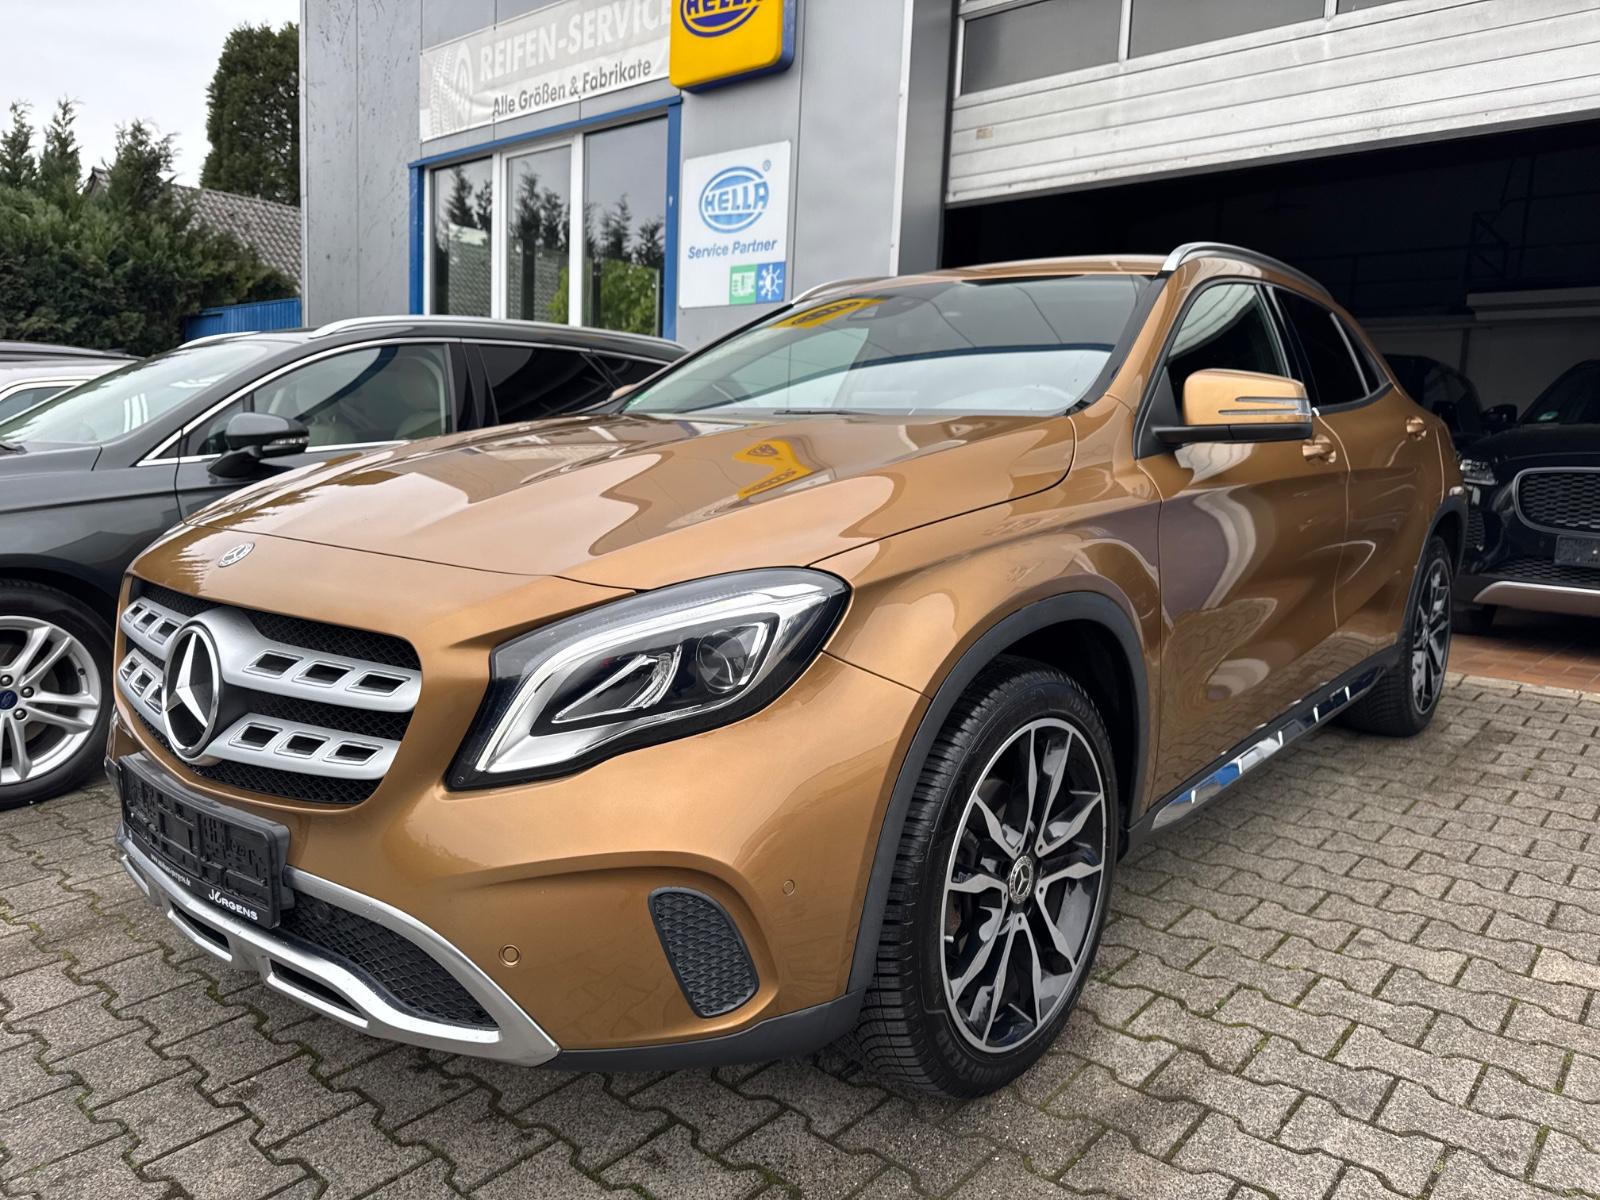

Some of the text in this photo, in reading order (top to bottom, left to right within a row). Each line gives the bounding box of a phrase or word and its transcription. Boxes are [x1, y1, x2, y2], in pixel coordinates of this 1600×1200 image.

[492, 58, 651, 117] Alle Größen & Fabrikate
[704, 180, 769, 212] HELLA
[688, 239, 777, 260] Service Partner
